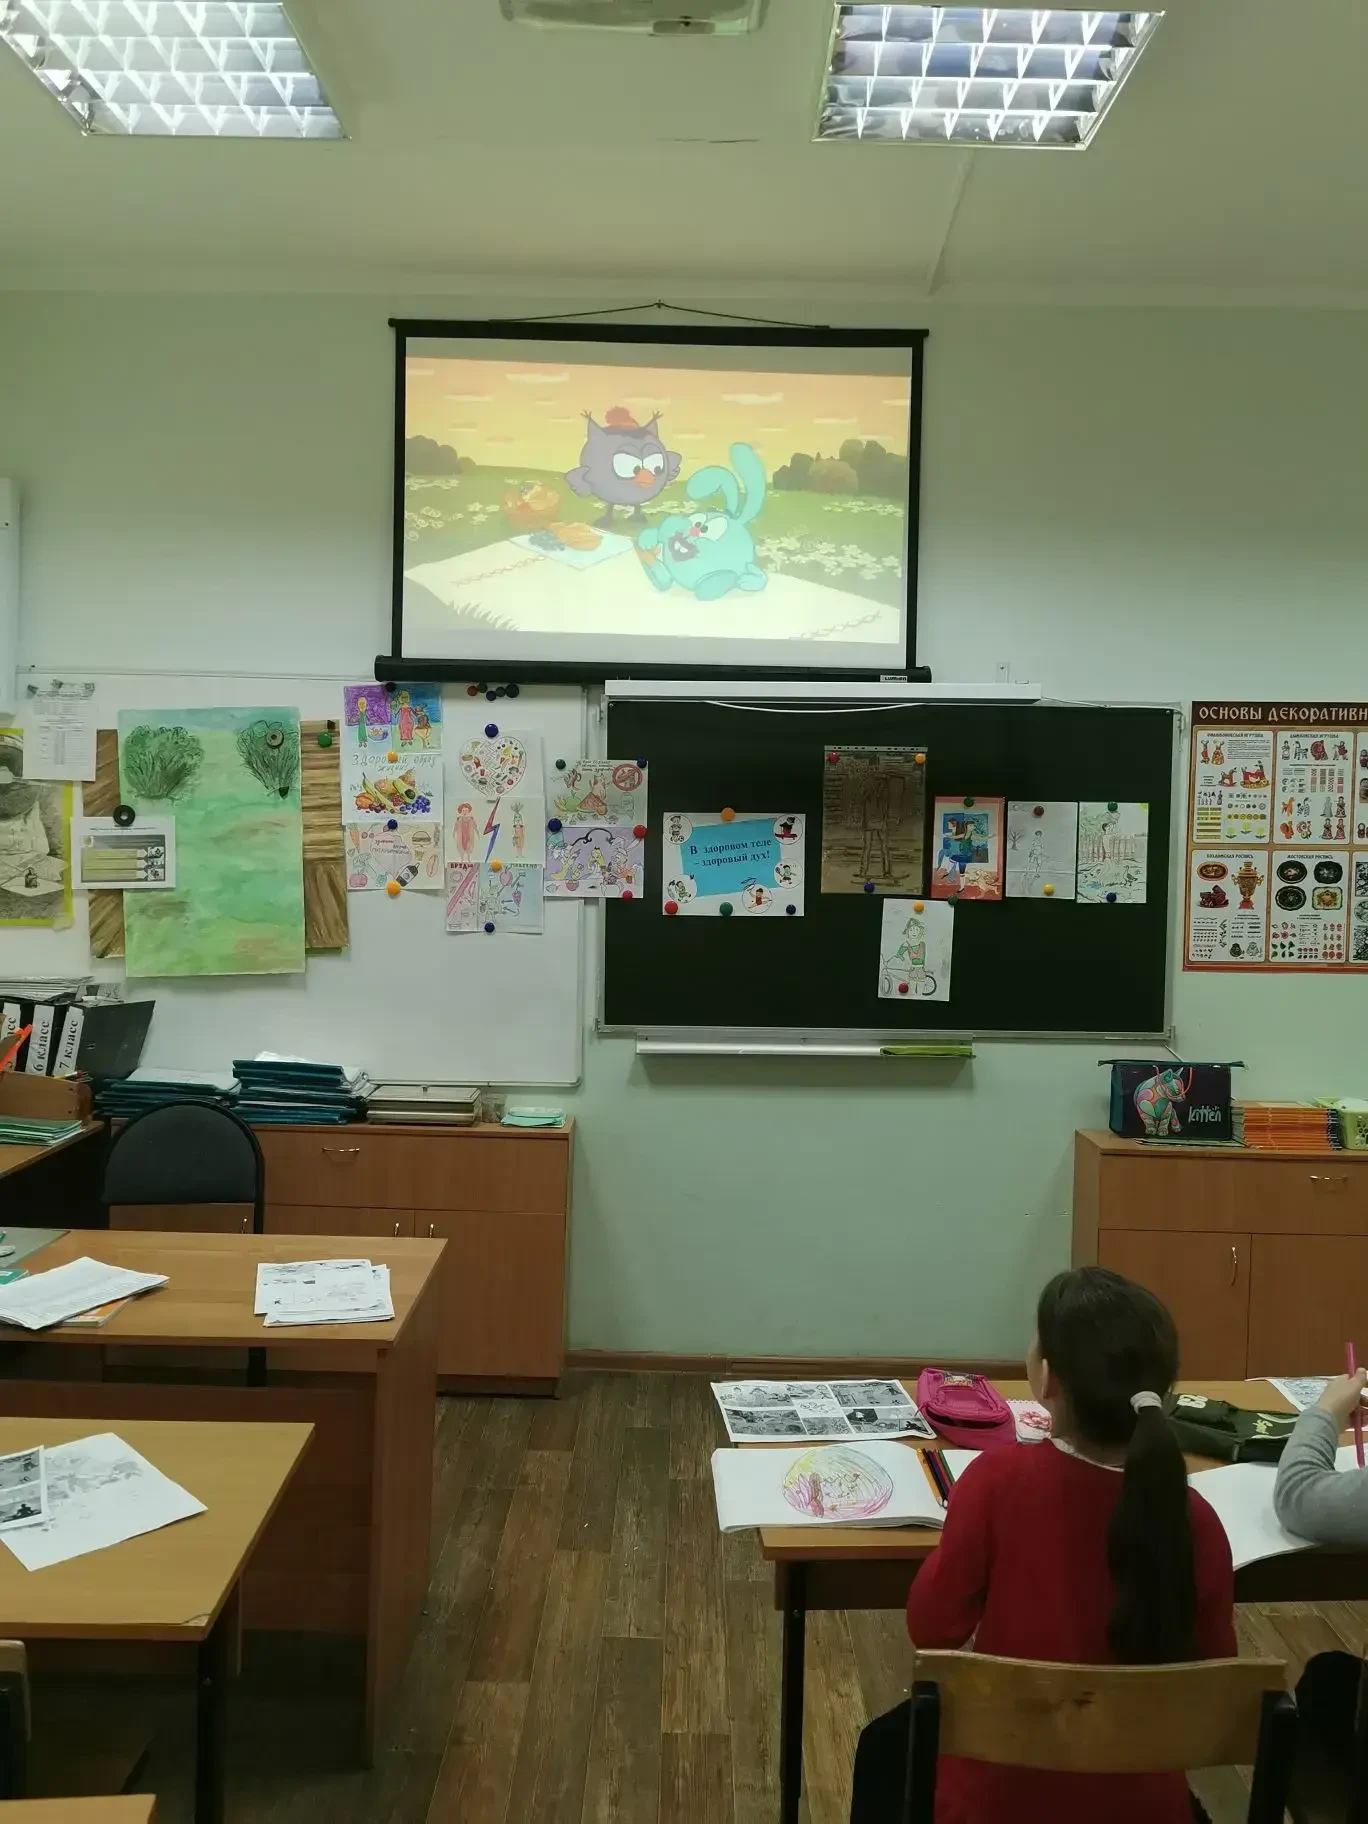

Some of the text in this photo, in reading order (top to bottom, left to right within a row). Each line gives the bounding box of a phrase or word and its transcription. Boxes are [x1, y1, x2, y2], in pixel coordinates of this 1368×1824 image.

[1199, 706, 1368, 723] ОСНОВЫ ДЕКОРАТИВН
[690, 839, 772, 855] В здоровом теле
[702, 853, 748, 867] здоровый
[751, 850, 770, 862] дух!
[33, 1021, 50, 1072] 6 класс
[59, 1020, 78, 1069] 7 класс
